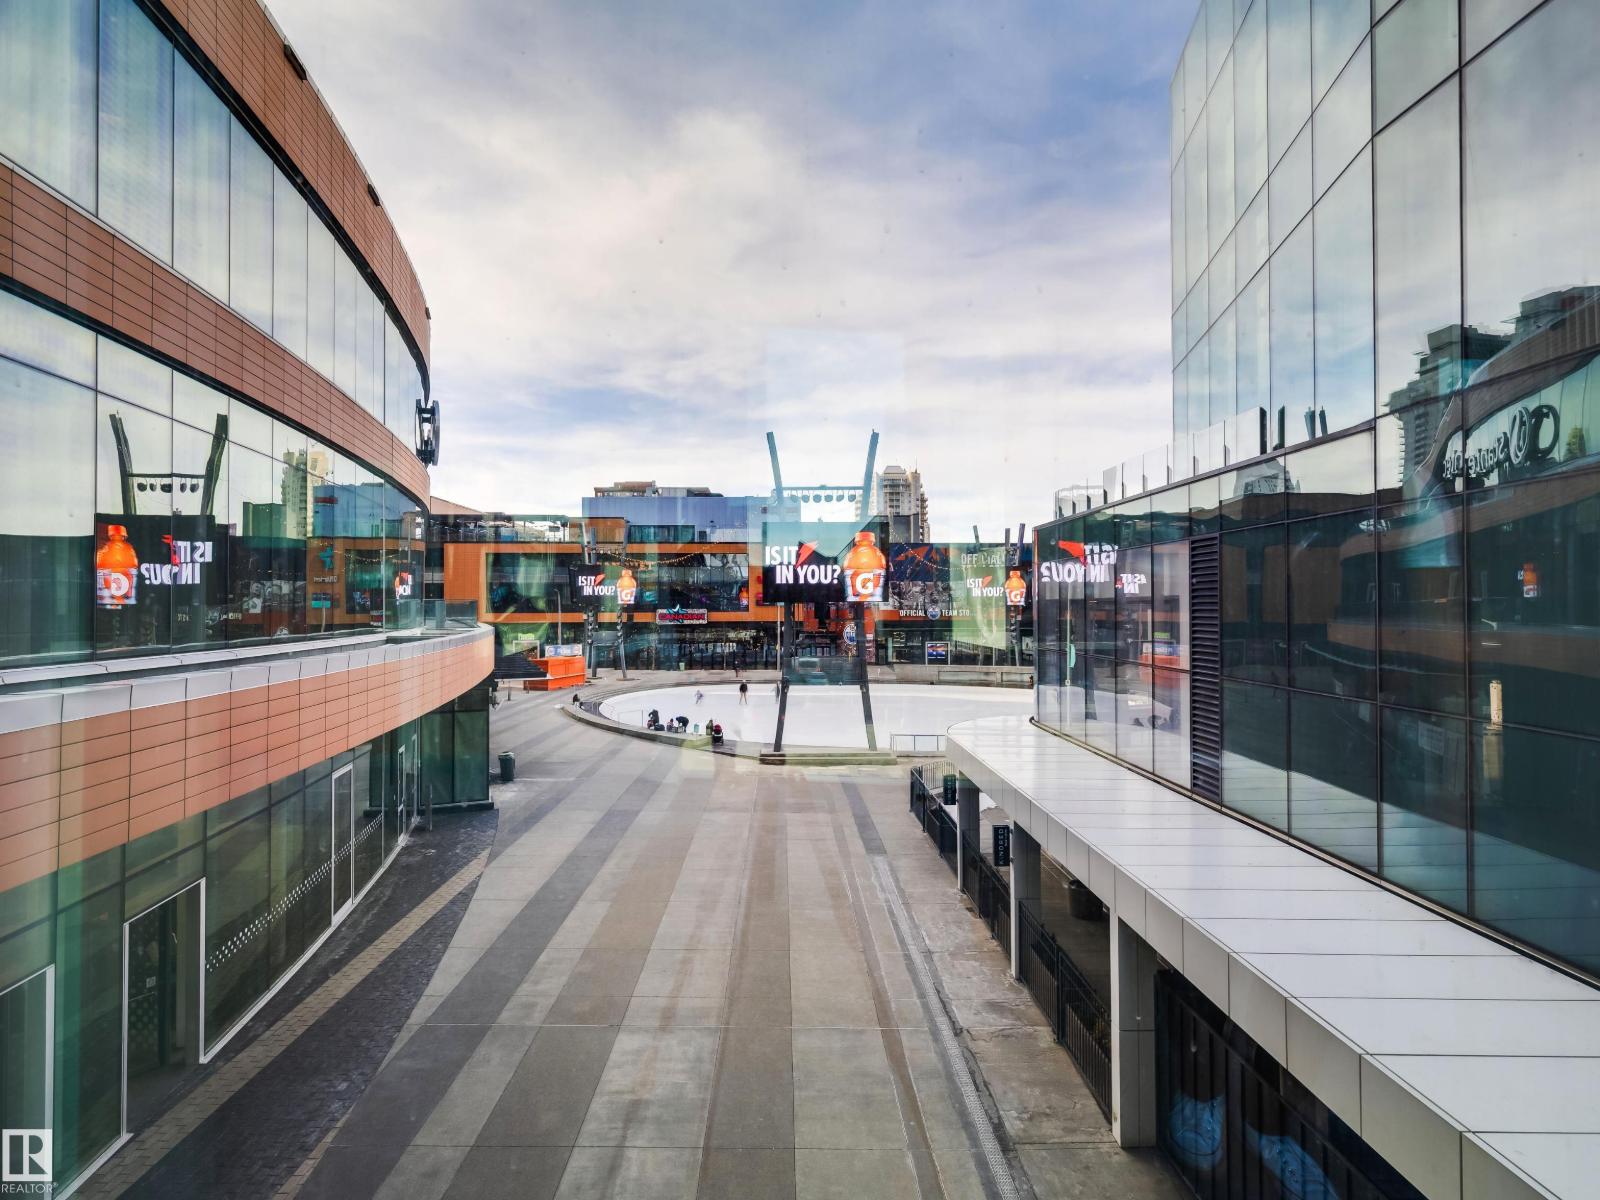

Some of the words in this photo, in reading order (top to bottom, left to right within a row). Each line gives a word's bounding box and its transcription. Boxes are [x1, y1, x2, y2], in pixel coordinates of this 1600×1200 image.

[765, 546, 781, 565] IS
[783, 546, 798, 565] IT
[775, 565, 793, 584] IN
[797, 565, 841, 584] YOU?
[578, 576, 587, 586] IS
[588, 576, 595, 586] IT
[855, 573, 874, 594] G
[967, 578, 975, 588] IS
[975, 578, 983, 588] IT
[584, 586, 593, 596] IN
[594, 586, 616, 596] YOU?
[972, 587, 981, 597] IN
[982, 587, 1004, 597] YOU?
[899, 609, 926, 617] OFFICIAL
[942, 609, 958, 617] TEAM
